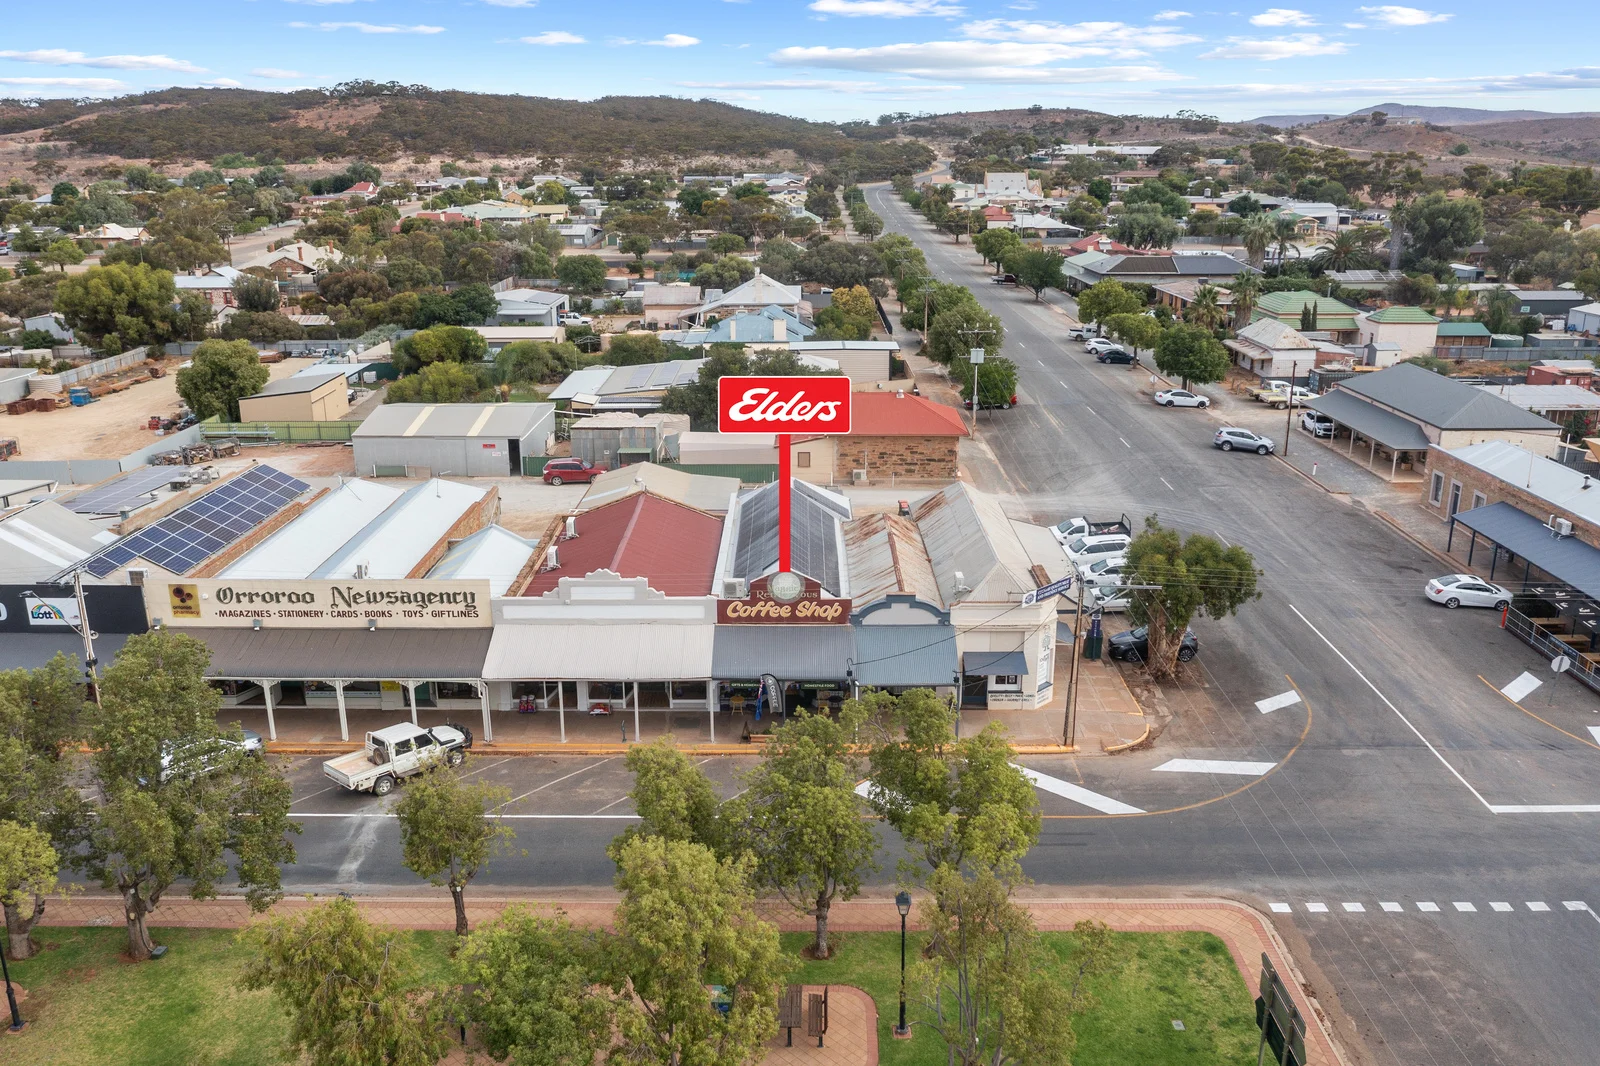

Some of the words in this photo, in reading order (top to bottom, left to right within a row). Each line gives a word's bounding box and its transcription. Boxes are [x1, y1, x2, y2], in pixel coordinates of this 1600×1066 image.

[215, 586, 315, 605] Orroroo
[330, 586, 477, 611] Newsagency
[31, 611, 54, 619] Lott
[219, 610, 271, 618] MAGAZINES
[278, 610, 324, 618] STATIONERY
[331, 610, 358, 618] CARDS
[365, 610, 392, 618] BOOKS
[402, 610, 424, 618] TOYS
[431, 610, 479, 618] GIFTLINES
[726, 600, 792, 618] Coffee
[795, 600, 843, 622] Shop
[770, 685, 778, 707] COFFEE
